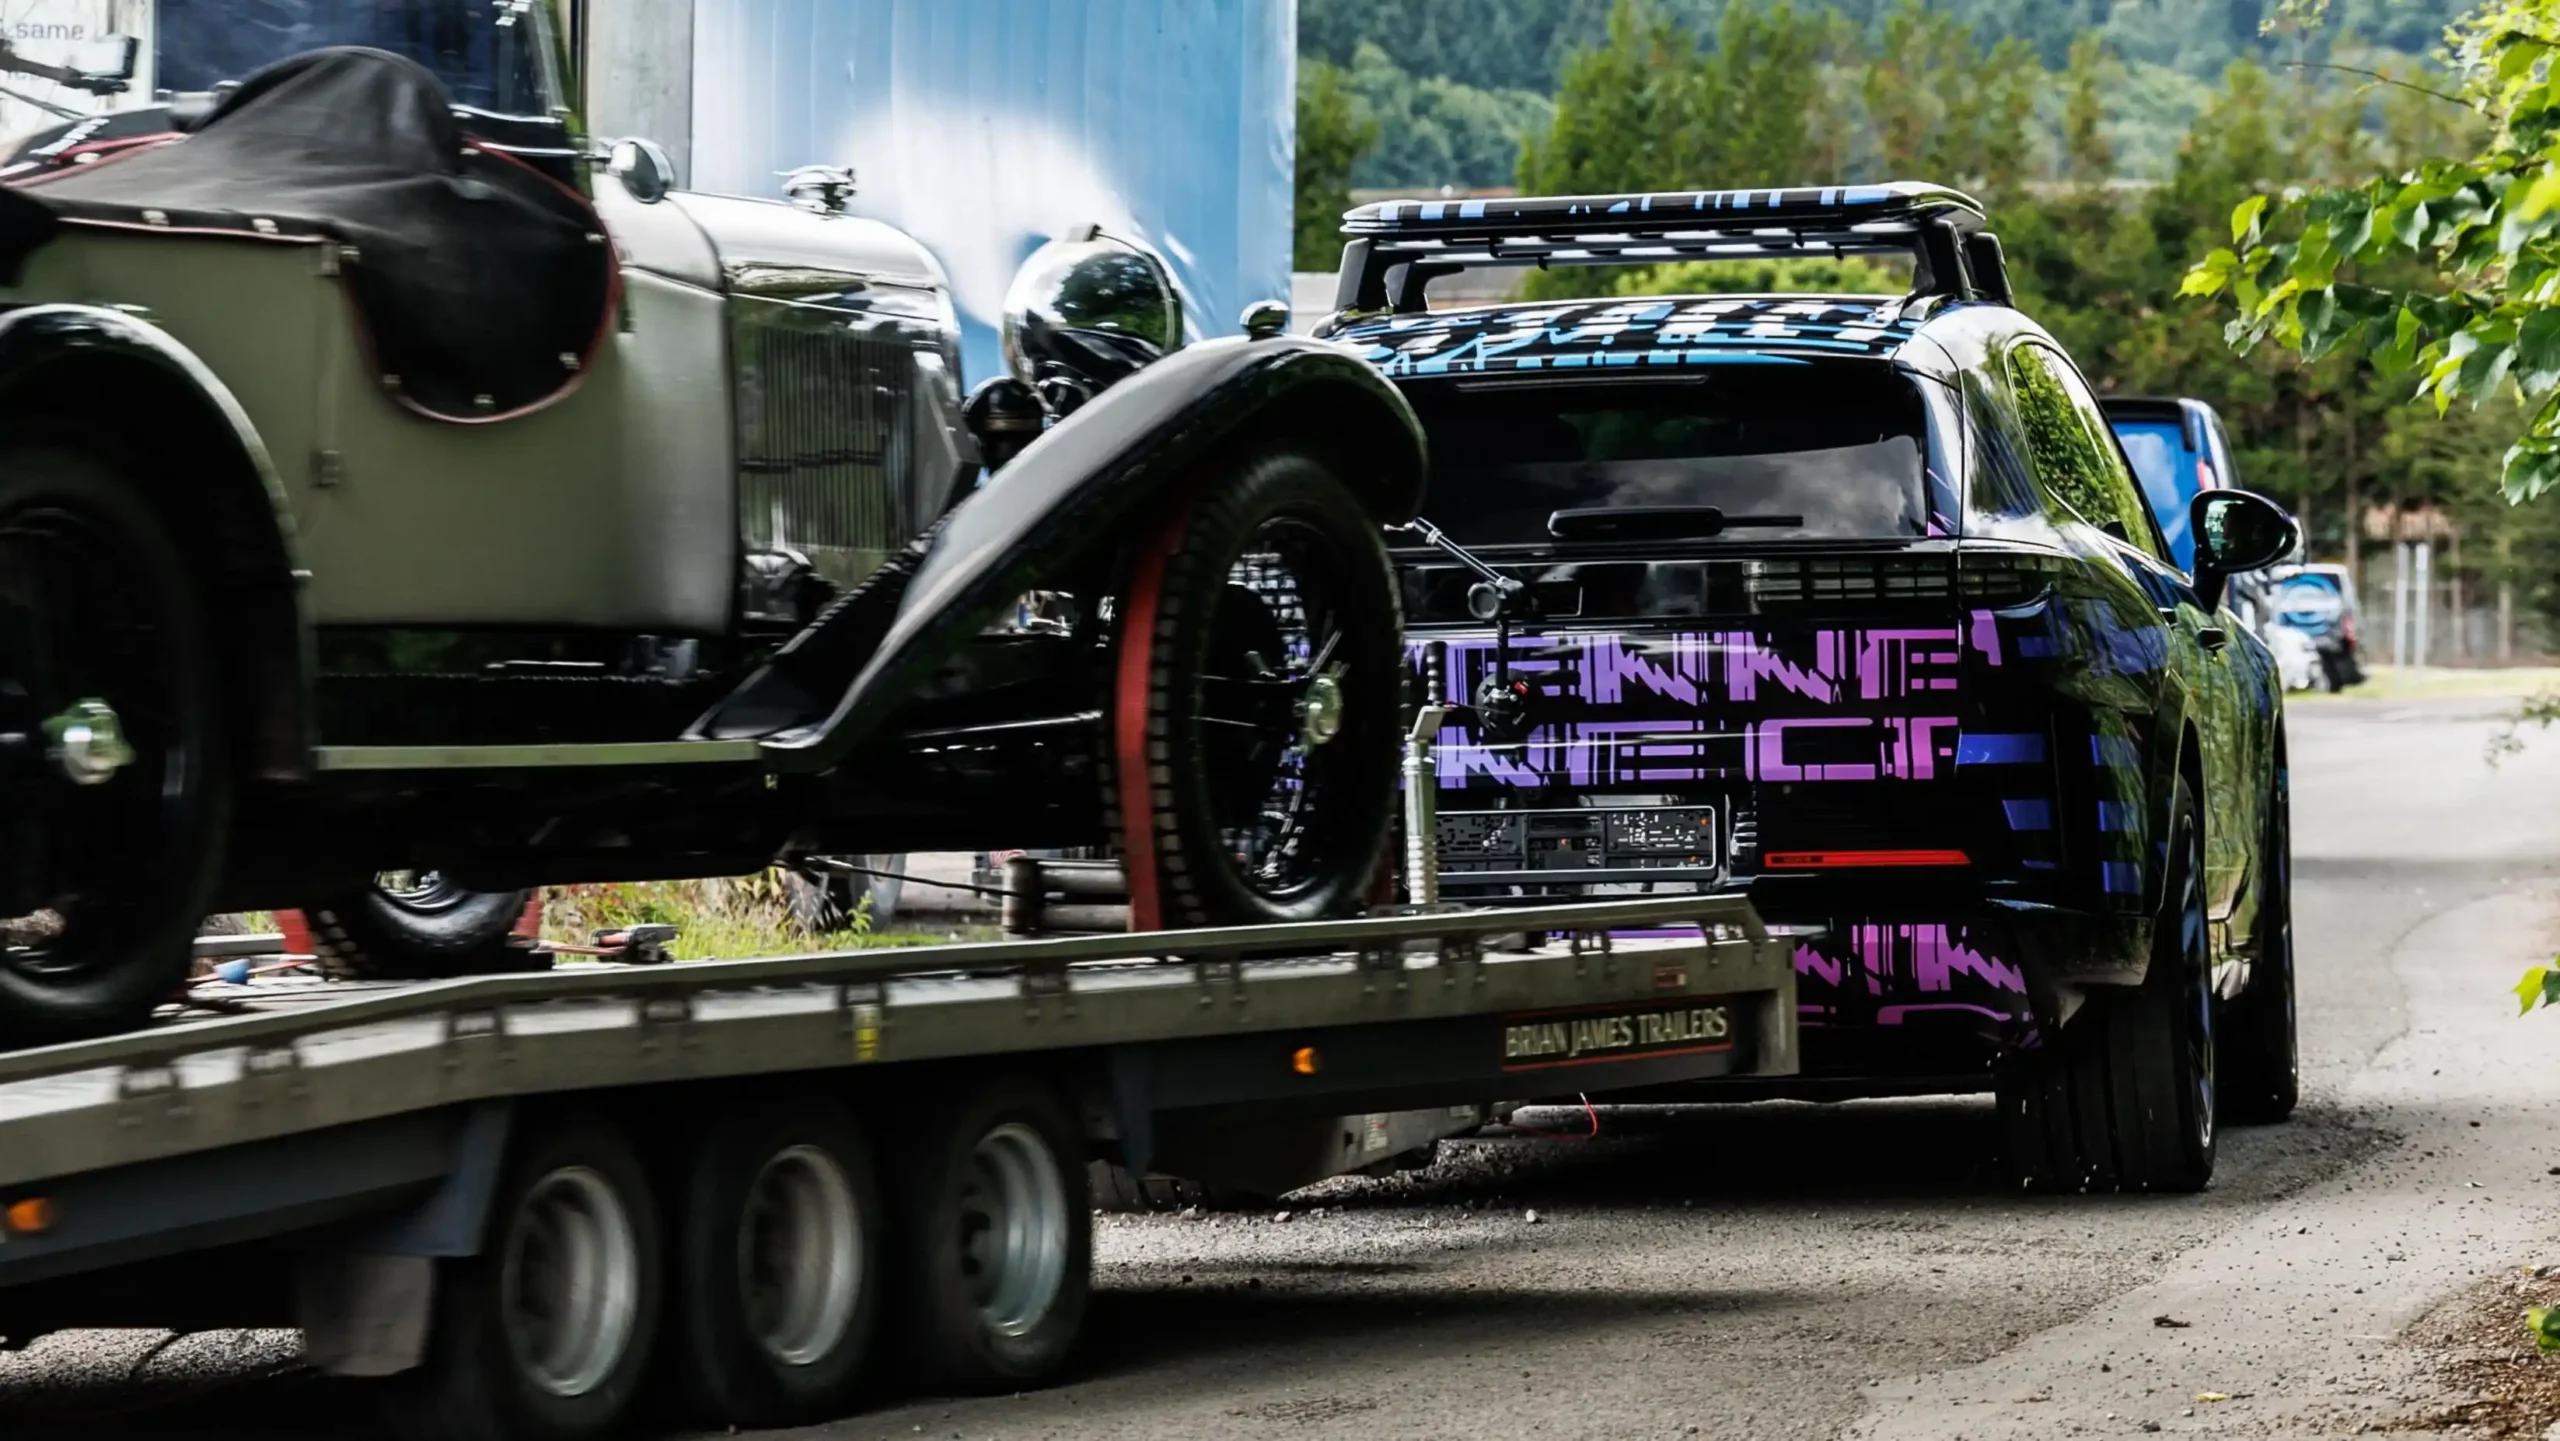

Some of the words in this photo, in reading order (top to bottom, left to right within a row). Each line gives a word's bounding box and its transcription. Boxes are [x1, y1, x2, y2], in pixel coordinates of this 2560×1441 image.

[16, 22, 84, 41] same
[1505, 1023, 1567, 1057] BRIAN
[1569, 1016, 1632, 1058] JAMES
[1637, 1007, 1728, 1044] TRAILERS
